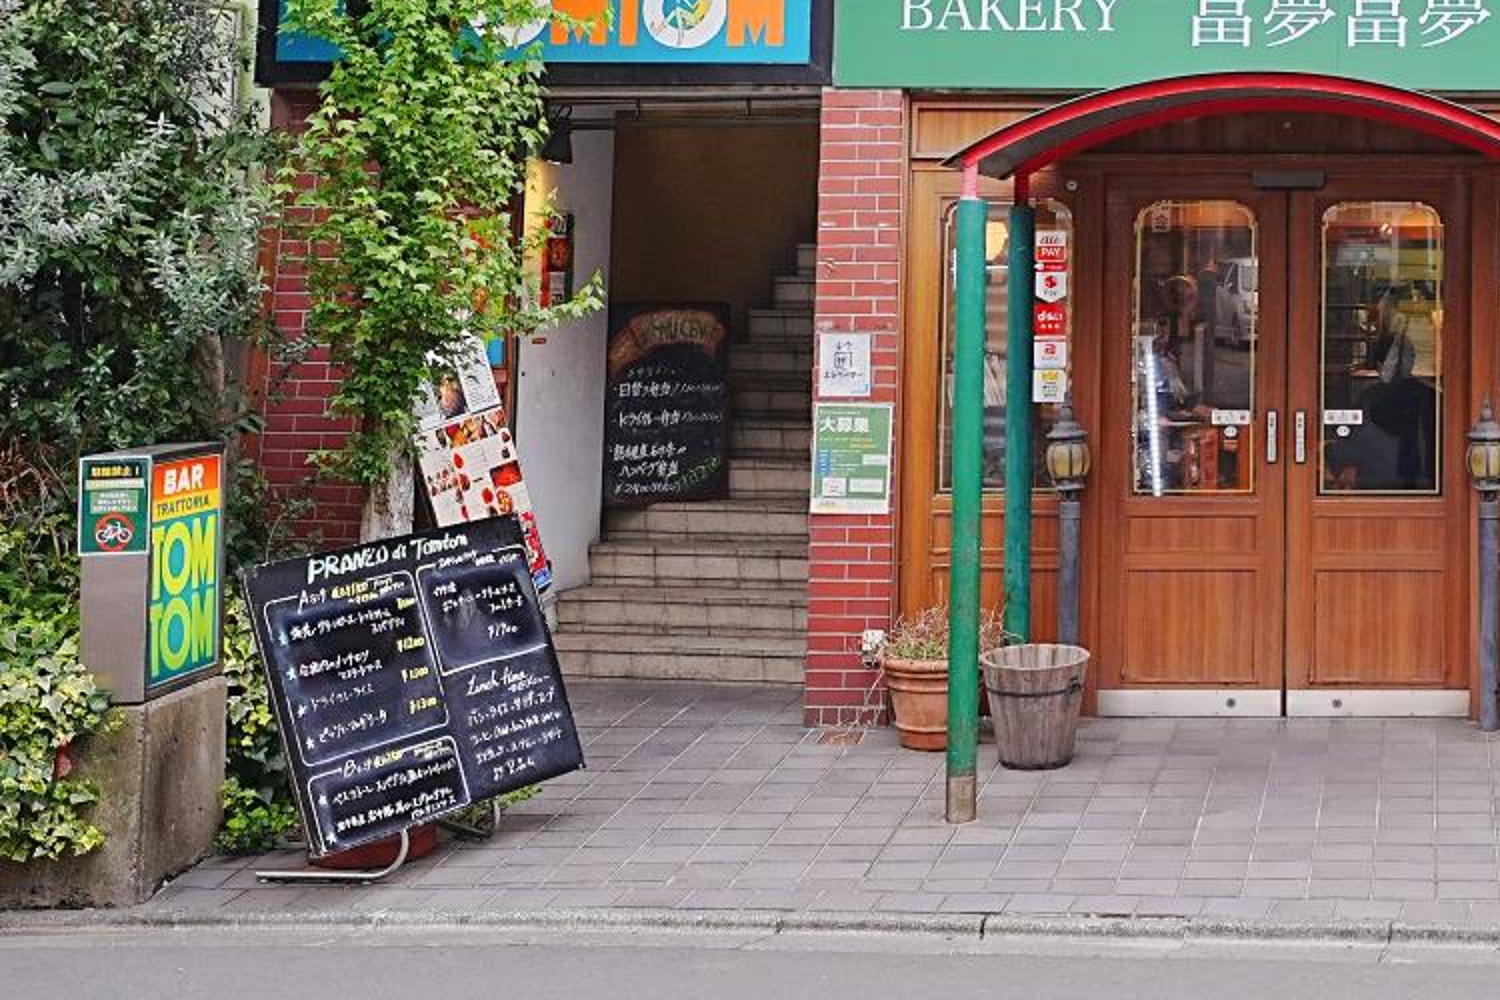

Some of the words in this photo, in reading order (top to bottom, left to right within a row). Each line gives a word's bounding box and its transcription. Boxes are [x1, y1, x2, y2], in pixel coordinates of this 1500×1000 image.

[163, 463, 205, 496] BAR
[151, 514, 217, 601] TOM
[149, 587, 215, 678] TOM
